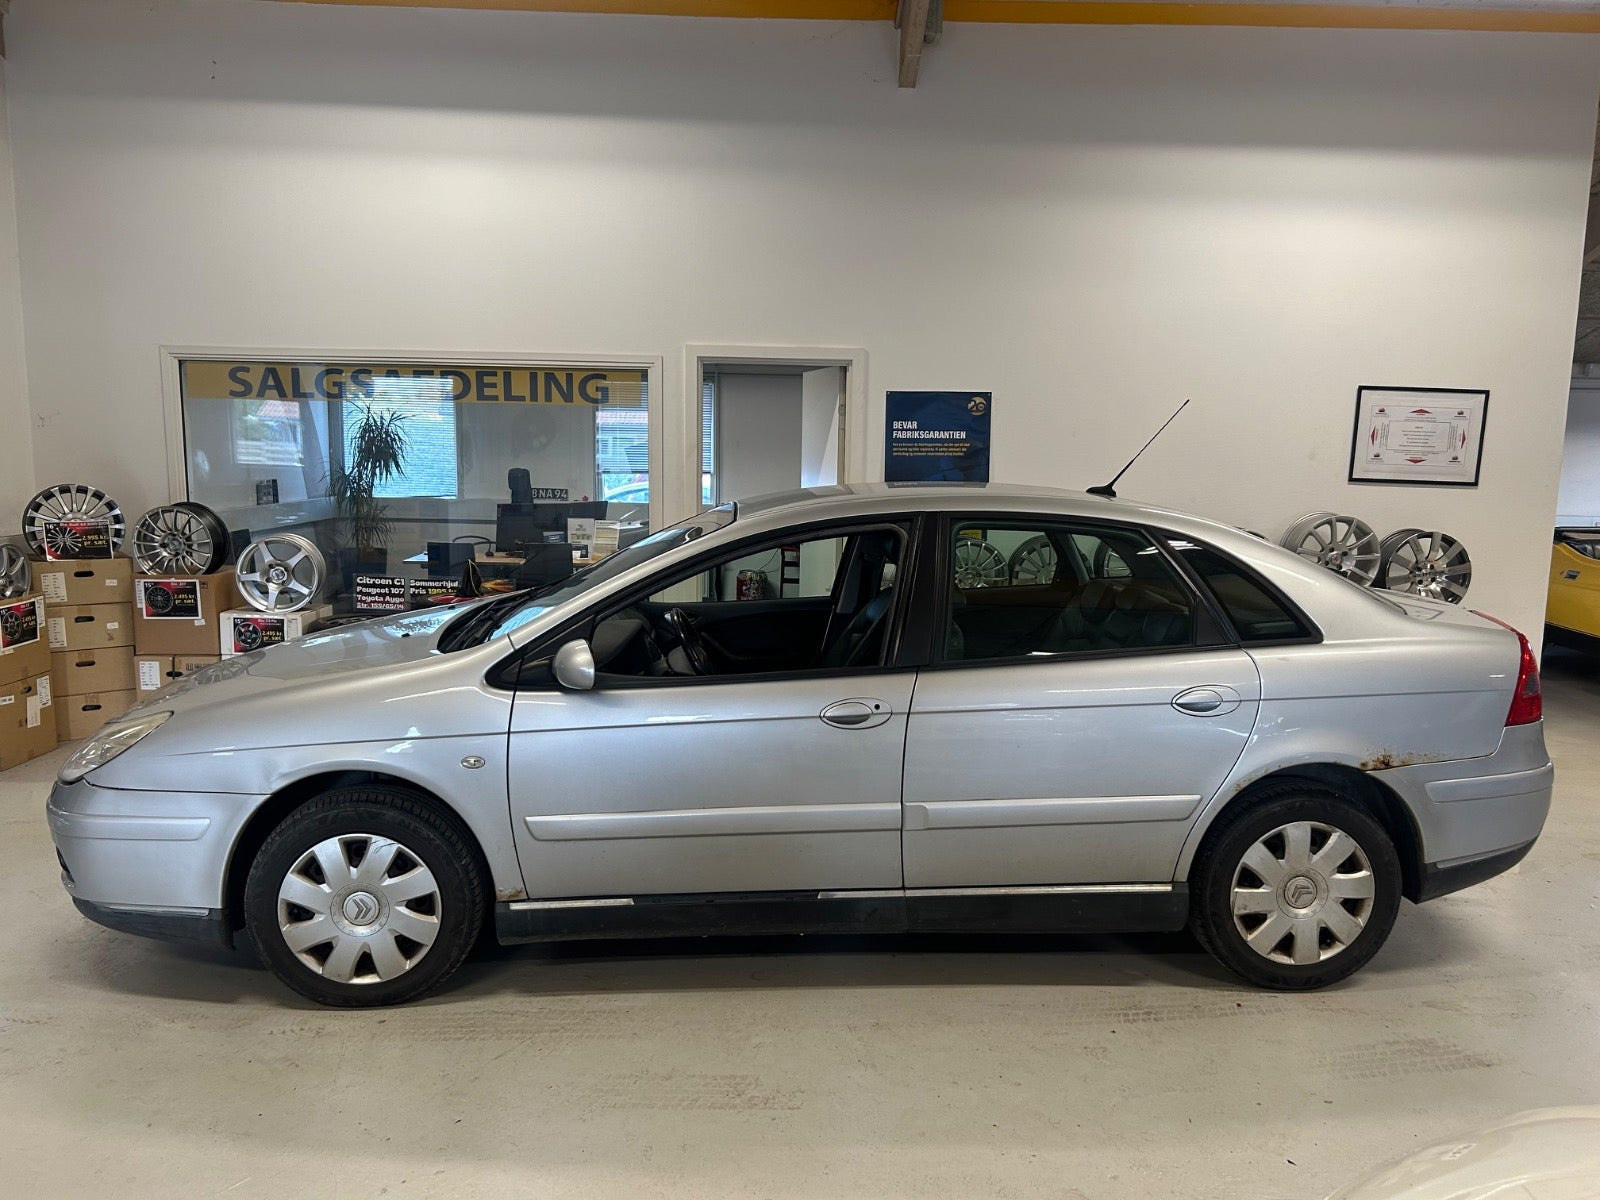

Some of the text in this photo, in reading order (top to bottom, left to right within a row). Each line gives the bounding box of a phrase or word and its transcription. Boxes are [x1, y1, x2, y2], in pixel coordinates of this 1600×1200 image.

[228, 365, 609, 404] SALGSDELING
[893, 421, 917, 429] BEVAR
[893, 430, 966, 439] FABRIKSGARANTIEN
[394, 578, 405, 586] C1
[409, 579, 459, 589] Sommerhjul
[357, 586, 389, 595] Peugeot
[409, 587, 427, 595] Pris
[357, 594, 384, 602] Toyota
